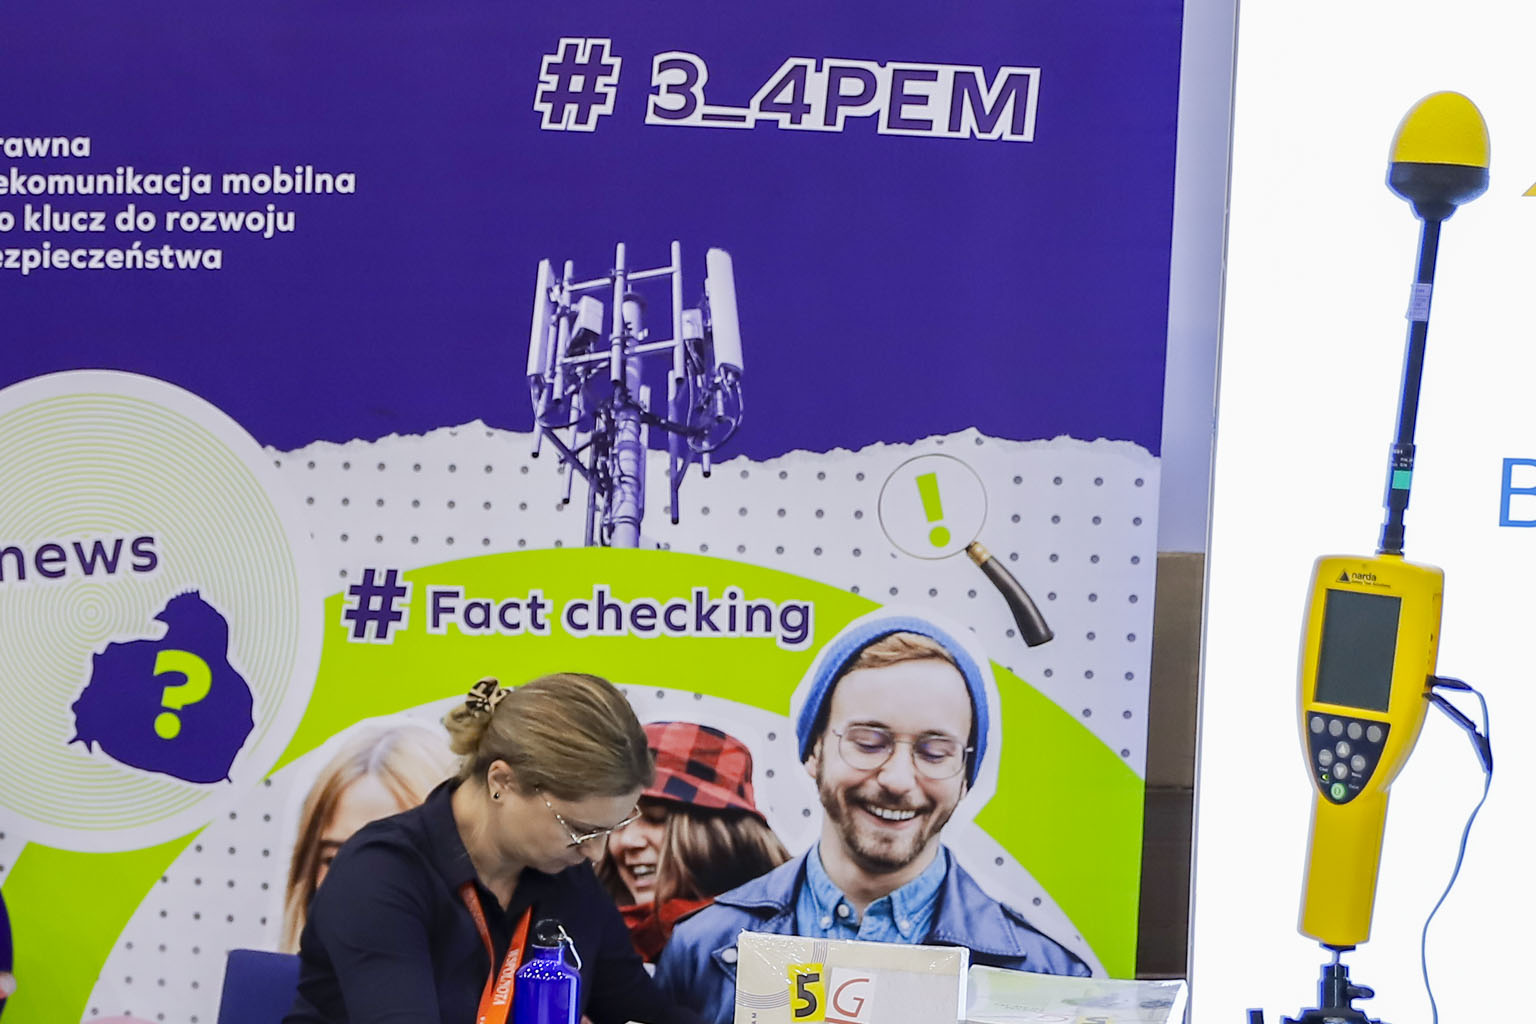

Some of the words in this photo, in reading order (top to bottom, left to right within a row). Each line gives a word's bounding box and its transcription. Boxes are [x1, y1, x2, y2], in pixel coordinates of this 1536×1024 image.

[222, 166, 356, 194] mobilna
[23, 206, 104, 232] klucz
[115, 206, 155, 232] do
[166, 207, 295, 239] rozwoju
[430, 590, 546, 632] Fact
[562, 590, 813, 642] checking
